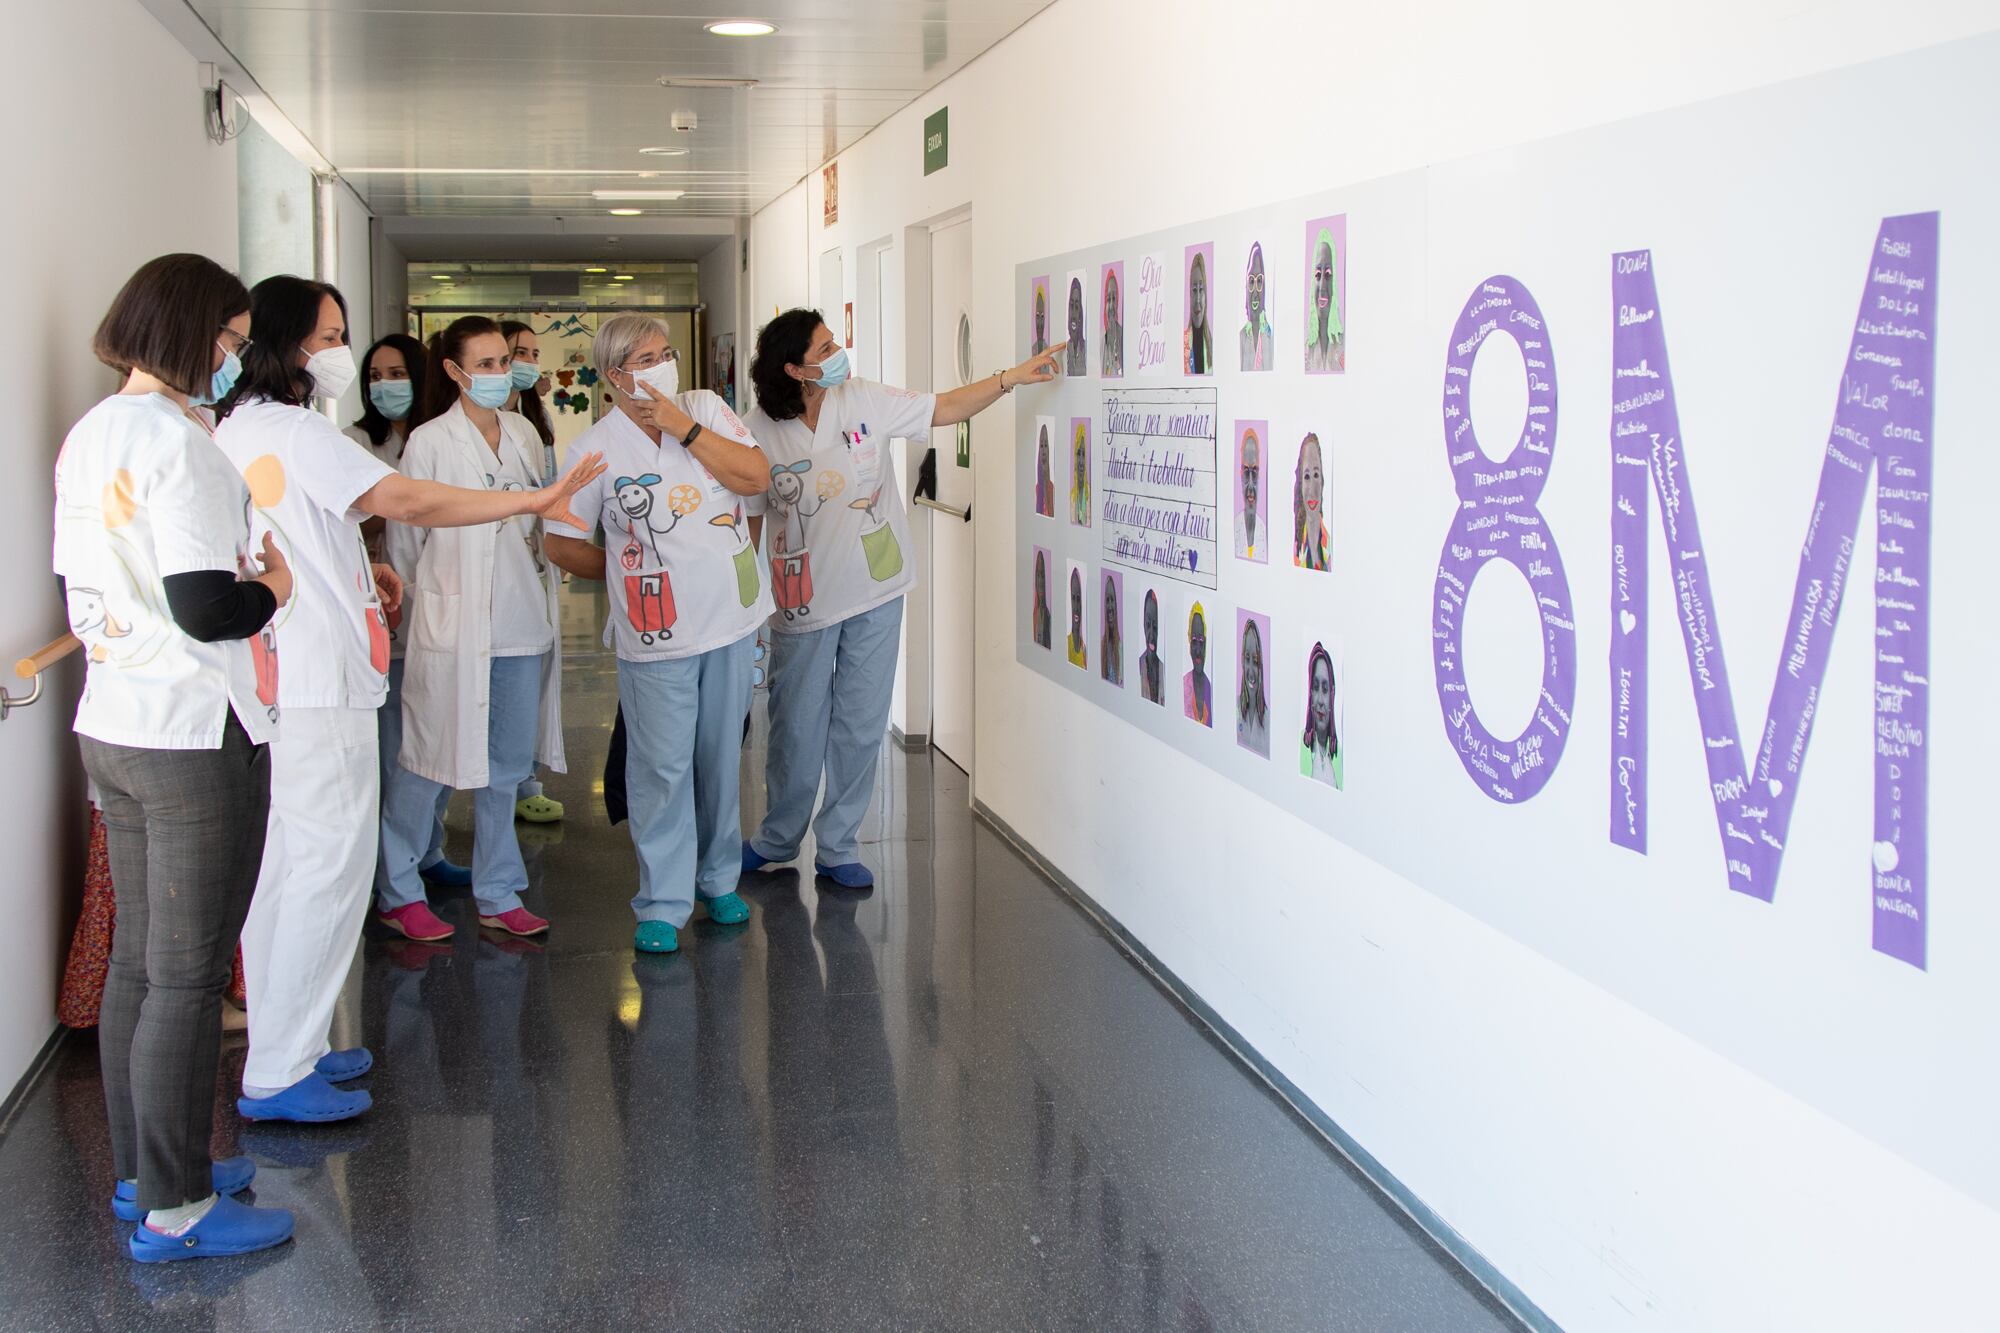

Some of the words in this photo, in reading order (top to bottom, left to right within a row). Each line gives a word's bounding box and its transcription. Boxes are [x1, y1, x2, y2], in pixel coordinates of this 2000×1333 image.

[1153, 289, 1164, 326] la
[1107, 447, 1138, 481] lluitar
[1140, 453, 1145, 482] i
[1147, 449, 1195, 488] treballar
[1103, 489, 1119, 521] dia
[1120, 503, 1128, 522] a
[1128, 494, 1145, 526] dia
[1139, 508, 1161, 539] per
[1877, 485, 1930, 504] IGUALTAT
[1116, 537, 1130, 560] un
[1153, 535, 1186, 572] millor
[1787, 578, 1823, 680] MERAVOLLOSA
[1617, 667, 1632, 739] IGUALTAT
[1876, 896, 1919, 921] VALENTA
